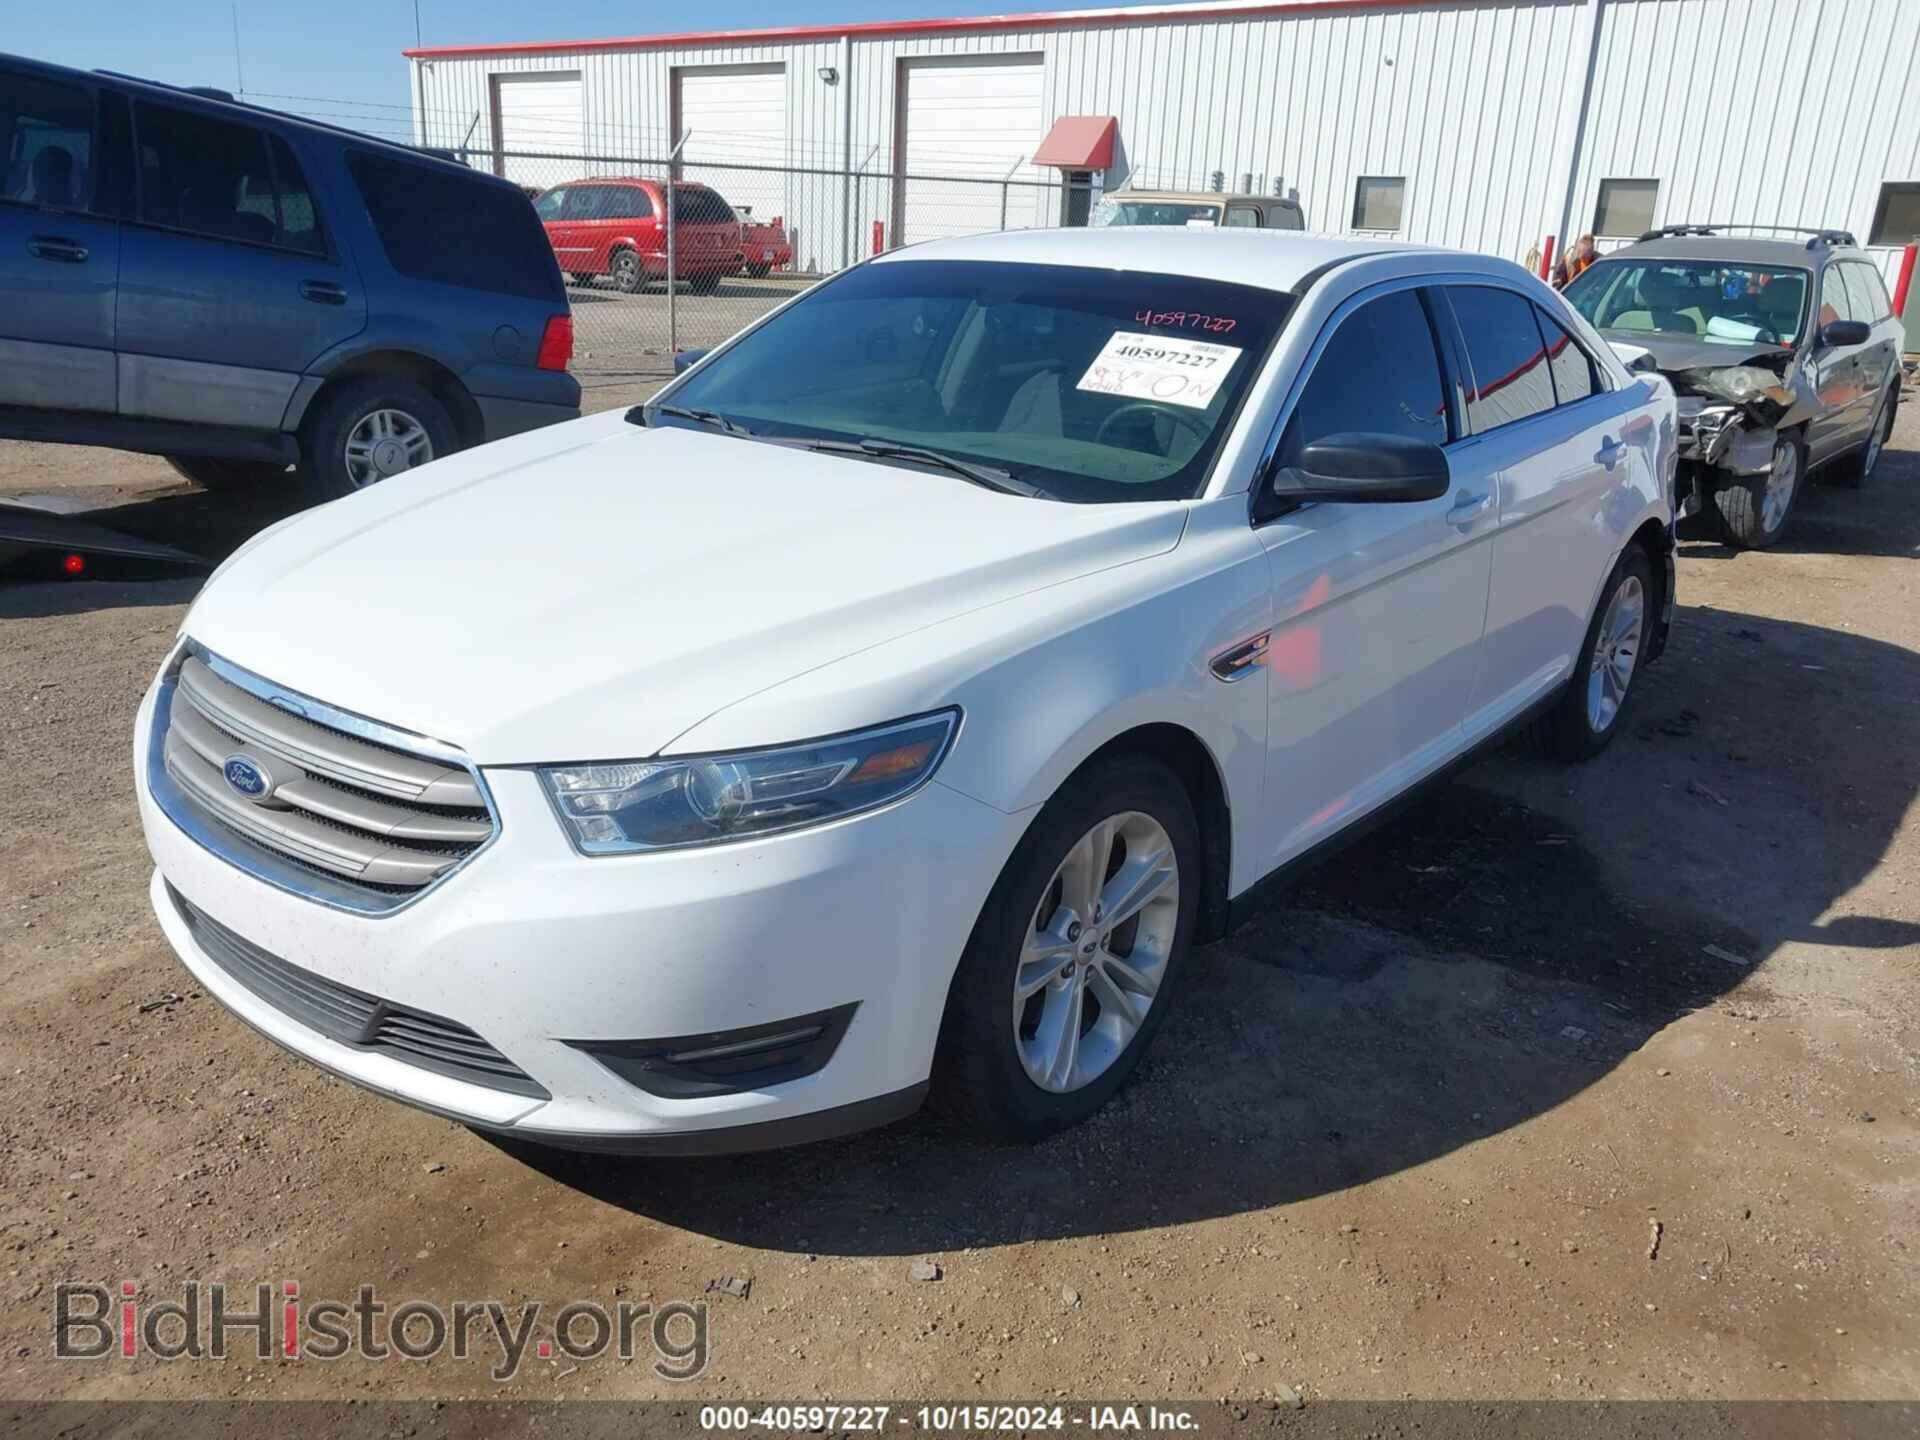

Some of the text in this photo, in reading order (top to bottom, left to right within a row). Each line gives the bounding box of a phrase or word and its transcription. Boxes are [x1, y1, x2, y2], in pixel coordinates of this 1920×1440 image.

[1135, 309, 1237, 333] 40597227
[1115, 345, 1218, 369] 40597227
[230, 763, 258, 791] Ford
